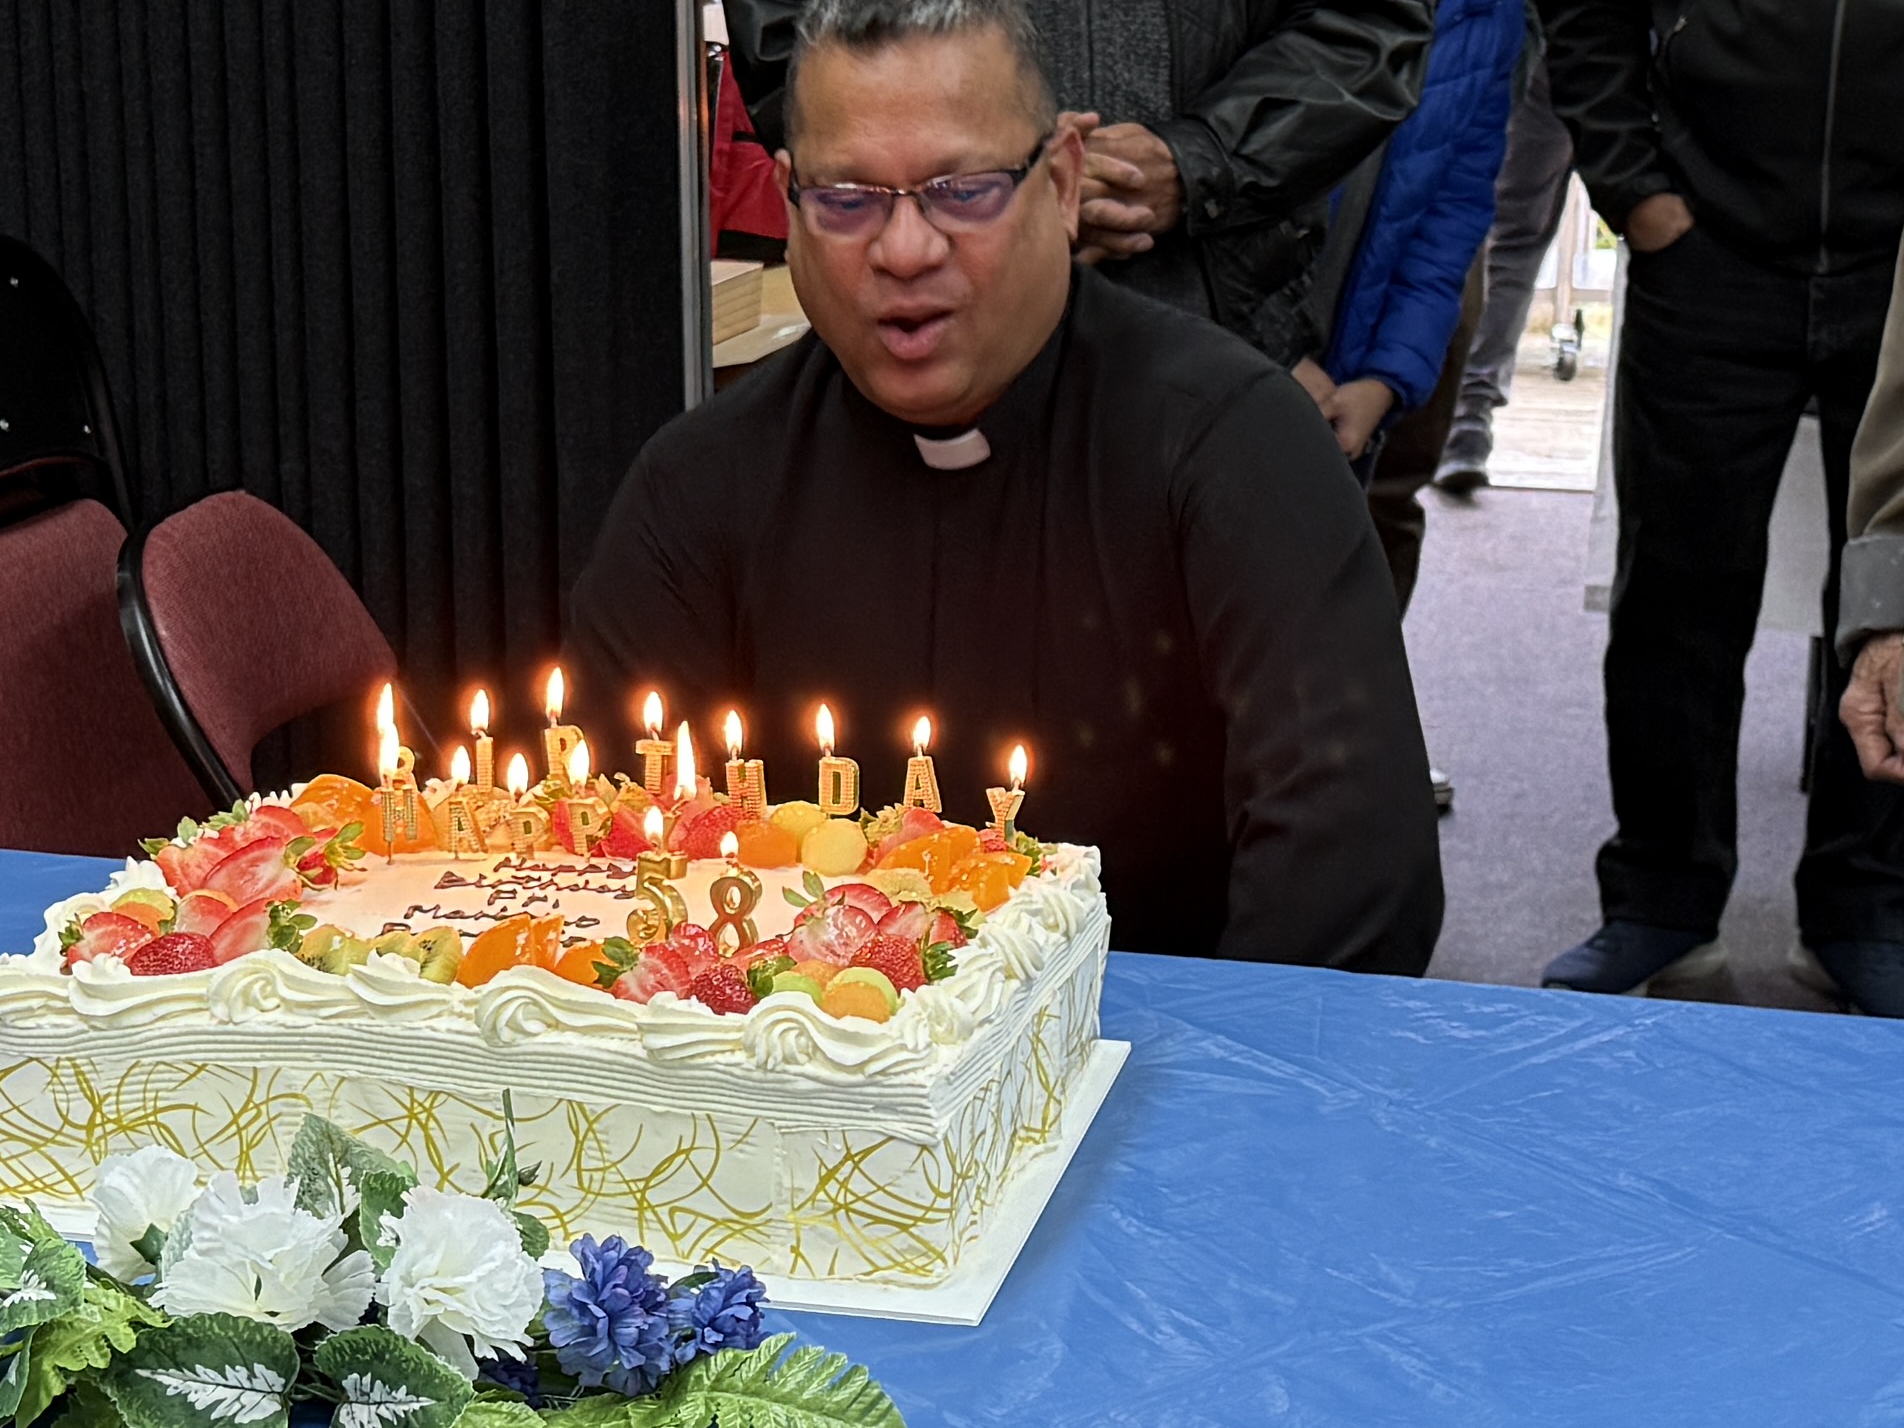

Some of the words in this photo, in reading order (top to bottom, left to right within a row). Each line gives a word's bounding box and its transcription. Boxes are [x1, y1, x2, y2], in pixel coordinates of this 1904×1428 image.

[492, 856, 637, 881] Happy
[433, 870, 637, 901] Birthday
[626, 849, 764, 959] 58
